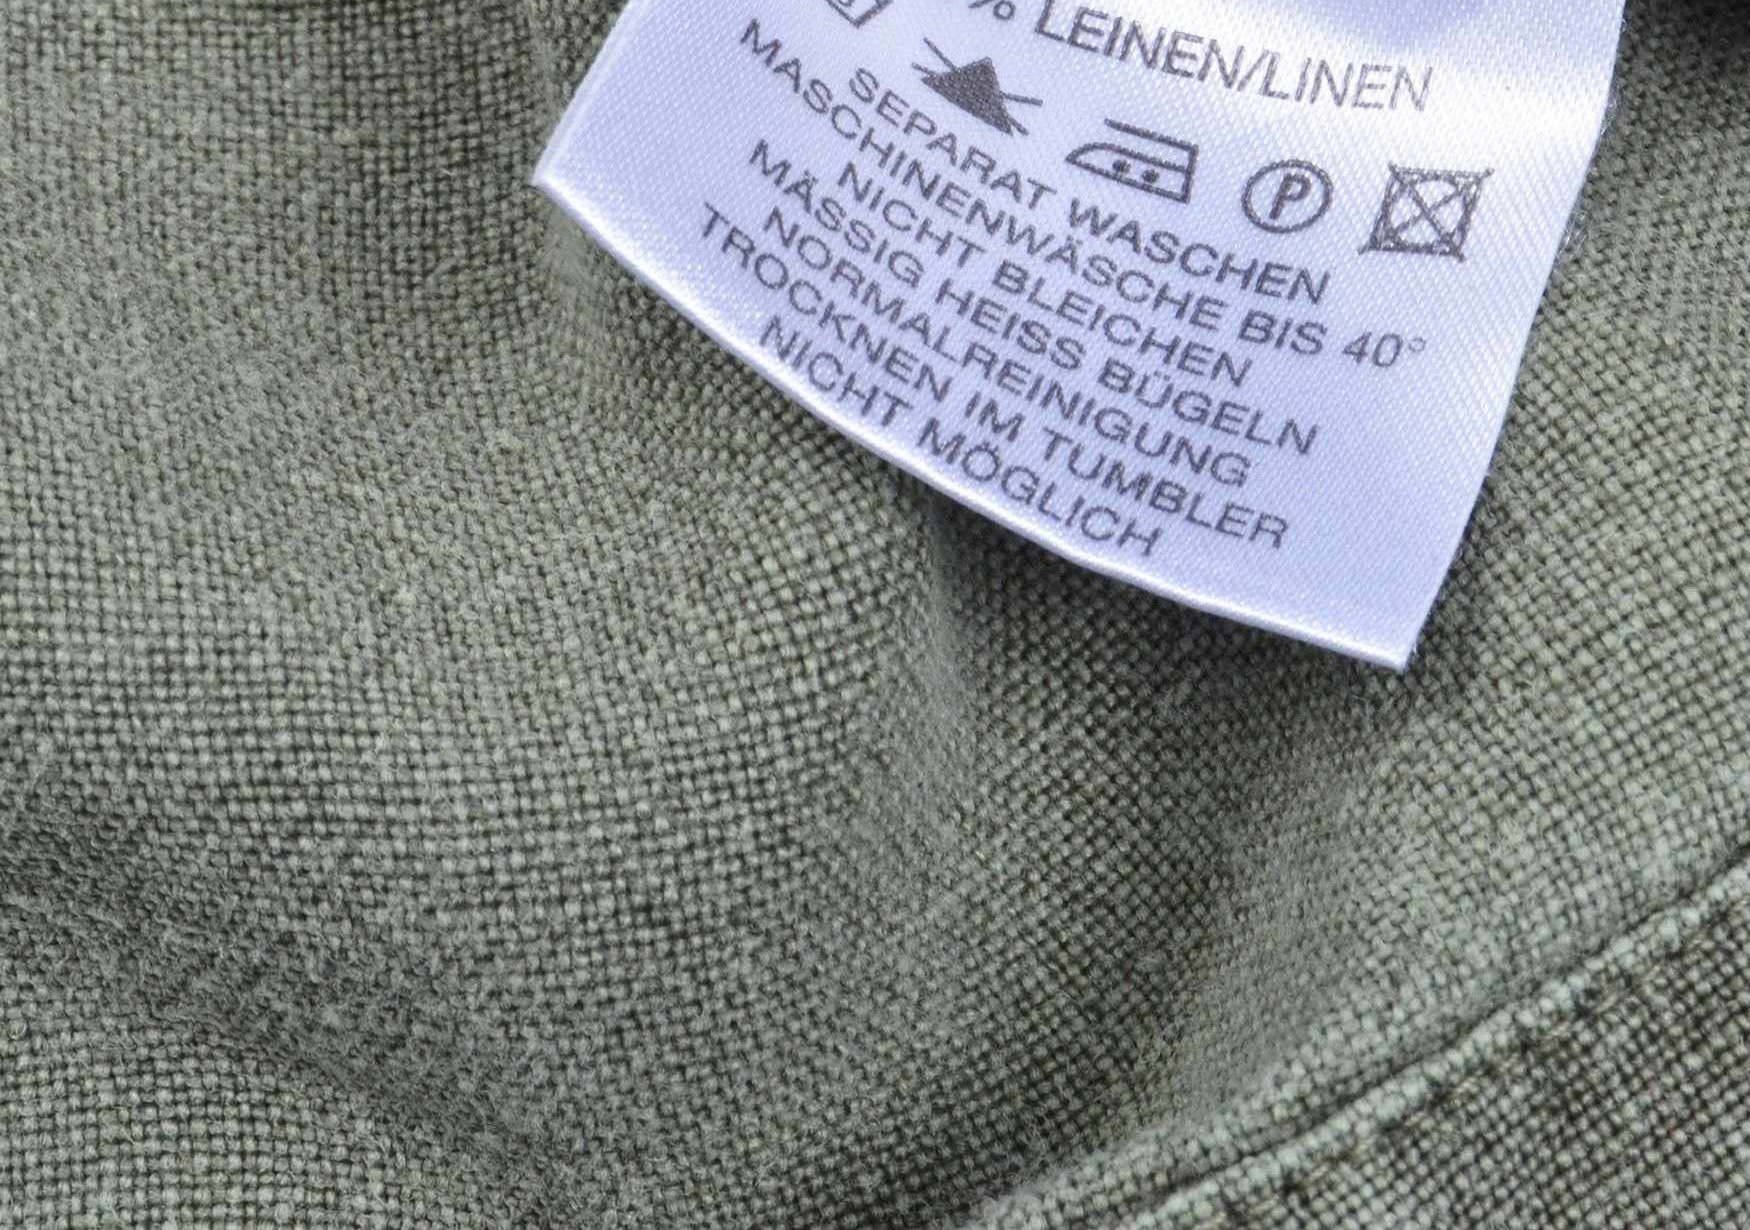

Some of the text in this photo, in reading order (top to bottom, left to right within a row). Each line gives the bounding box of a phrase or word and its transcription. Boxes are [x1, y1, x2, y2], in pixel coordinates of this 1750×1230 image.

[740, 19, 1426, 368] MASCHINENWÄSCHE BIS 40°
[749, 139, 1319, 454] MÄSSIG HEISS BÜGELN
[838, 161, 1253, 387] NICHT BLEICHEN
[850, 68, 1331, 304] SEPARAT WASCHEN
[1269, 172, 1311, 220] P
[704, 201, 1289, 548] TROCKNEN IM TUMBLER
[760, 315, 1163, 556] NICHT MÖGLICH
[763, 206, 1251, 488] NORMALREINIGUNG
